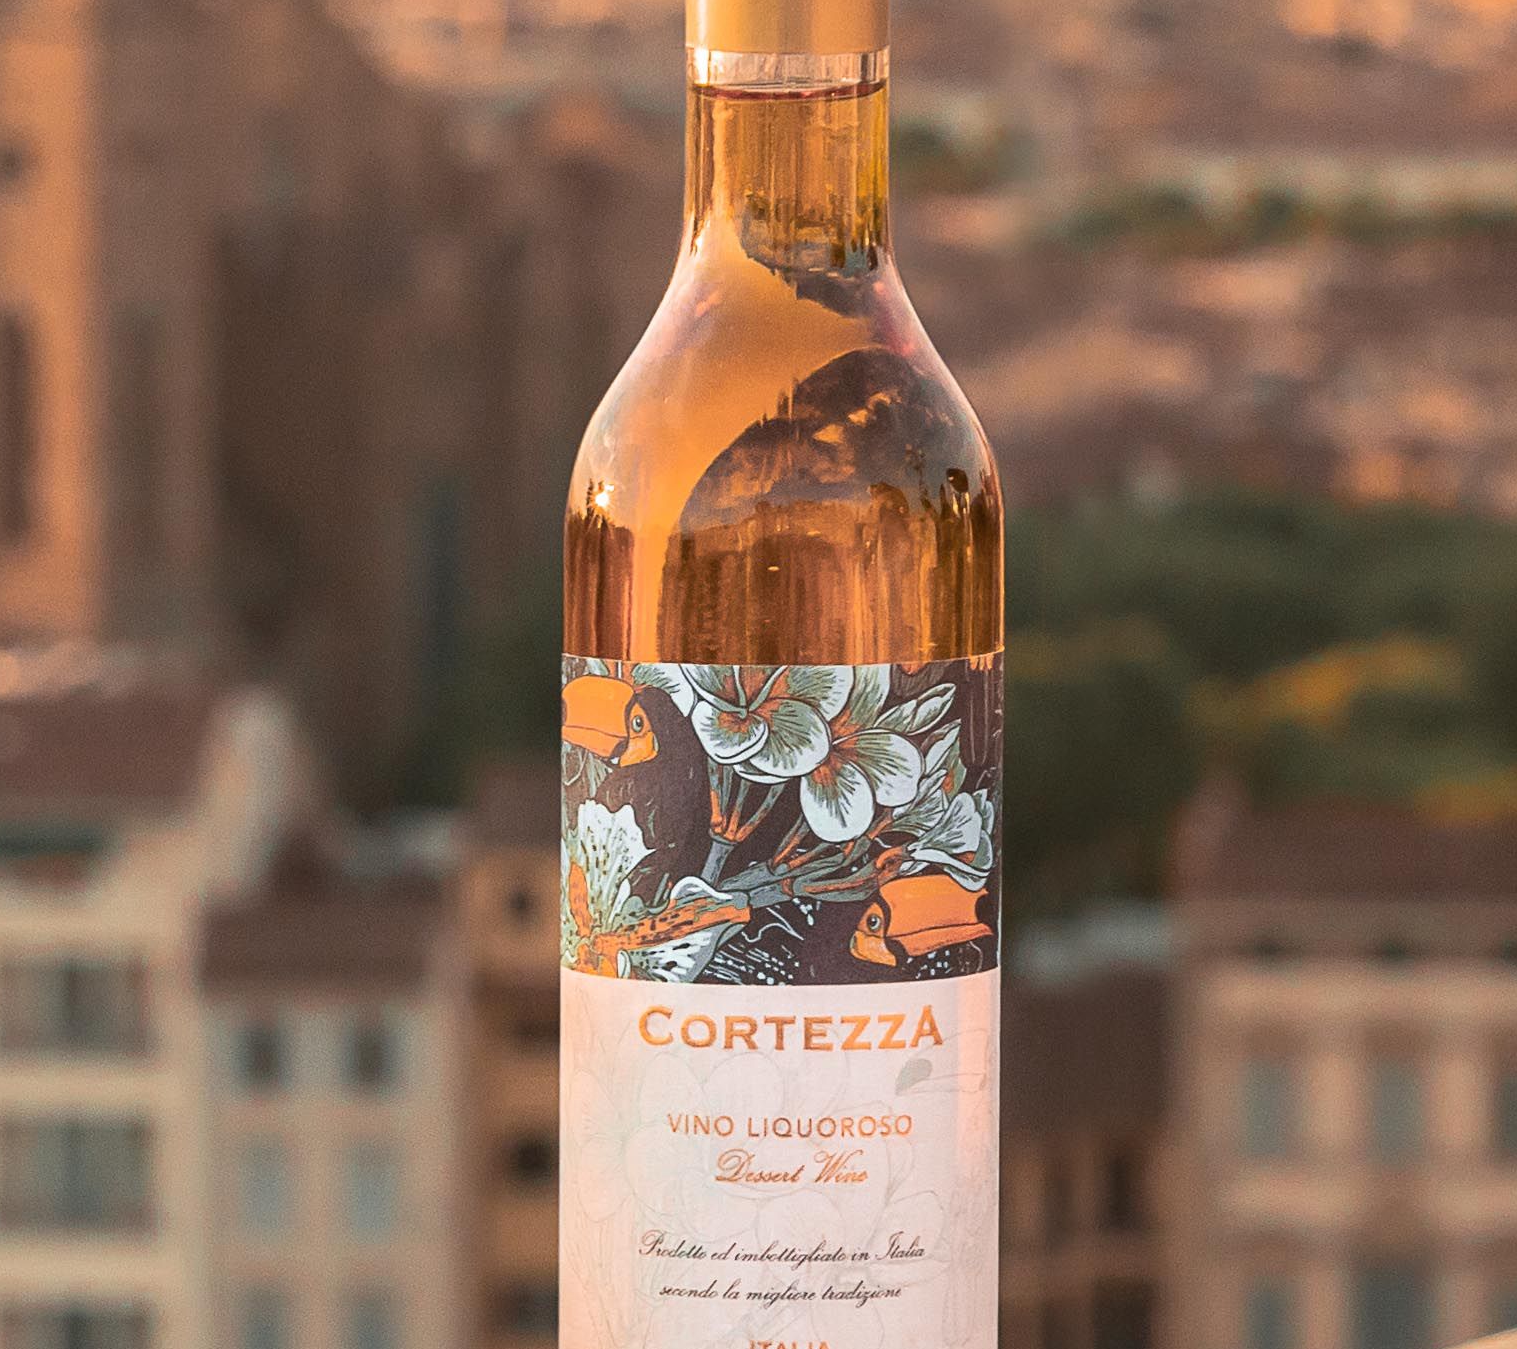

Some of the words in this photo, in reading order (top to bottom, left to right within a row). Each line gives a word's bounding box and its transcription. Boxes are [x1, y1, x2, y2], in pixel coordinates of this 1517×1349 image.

[638, 1004, 944, 1052] CORTEZZA
[667, 1113, 734, 1137] VINO
[747, 1113, 913, 1138] LIQUOROSO
[715, 1147, 806, 1184] Dessert
[812, 1148, 869, 1184] Wine
[638, 1229, 708, 1260] Prodotto
[710, 1241, 732, 1261] ed
[734, 1240, 847, 1270] imbottigliato
[851, 1244, 870, 1261] in
[875, 1230, 926, 1261] Italia
[659, 1280, 718, 1300] secondo
[721, 1279, 739, 1300] la
[746, 1281, 818, 1309] migliore
[822, 1279, 902, 1307] tradizione
